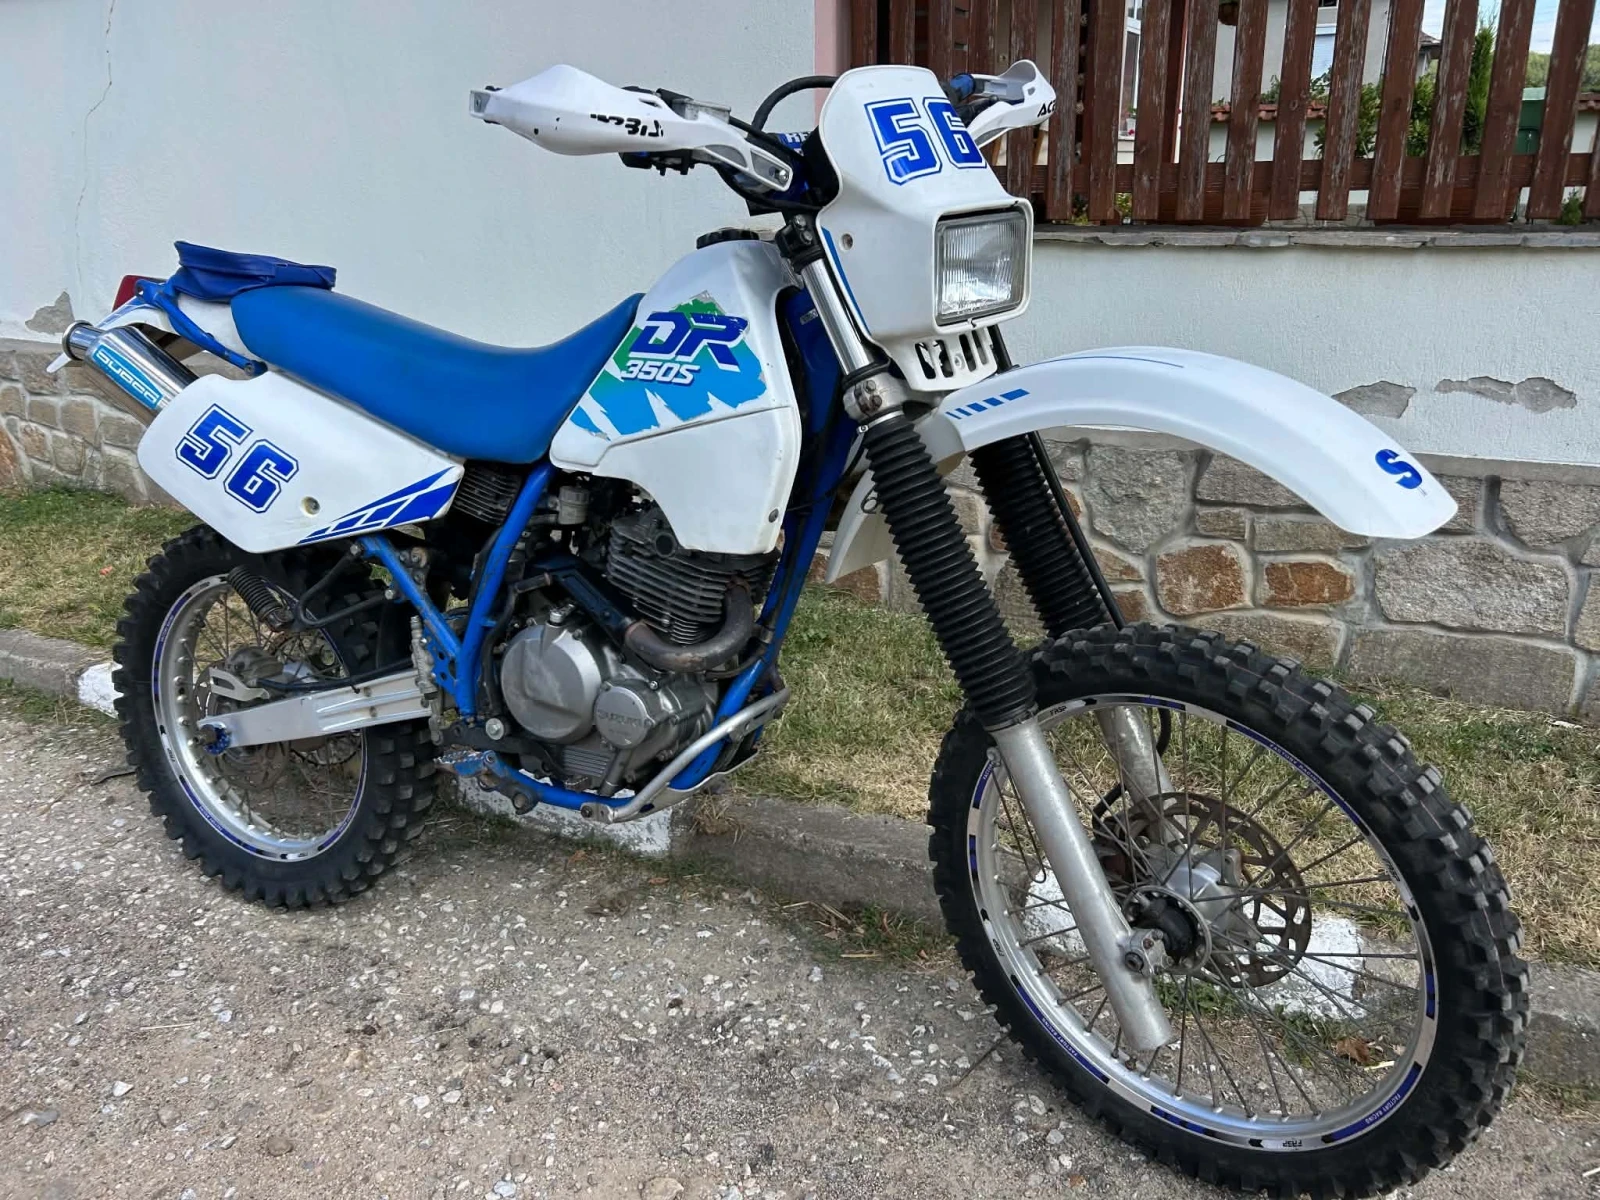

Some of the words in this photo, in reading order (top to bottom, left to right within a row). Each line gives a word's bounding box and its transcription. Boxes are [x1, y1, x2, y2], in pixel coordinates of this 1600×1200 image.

[863, 97, 988, 186] 56
[620, 359, 702, 387] 350S
[628, 311, 748, 373] DR
[175, 403, 300, 514] 56
[1374, 448, 1423, 490] S
